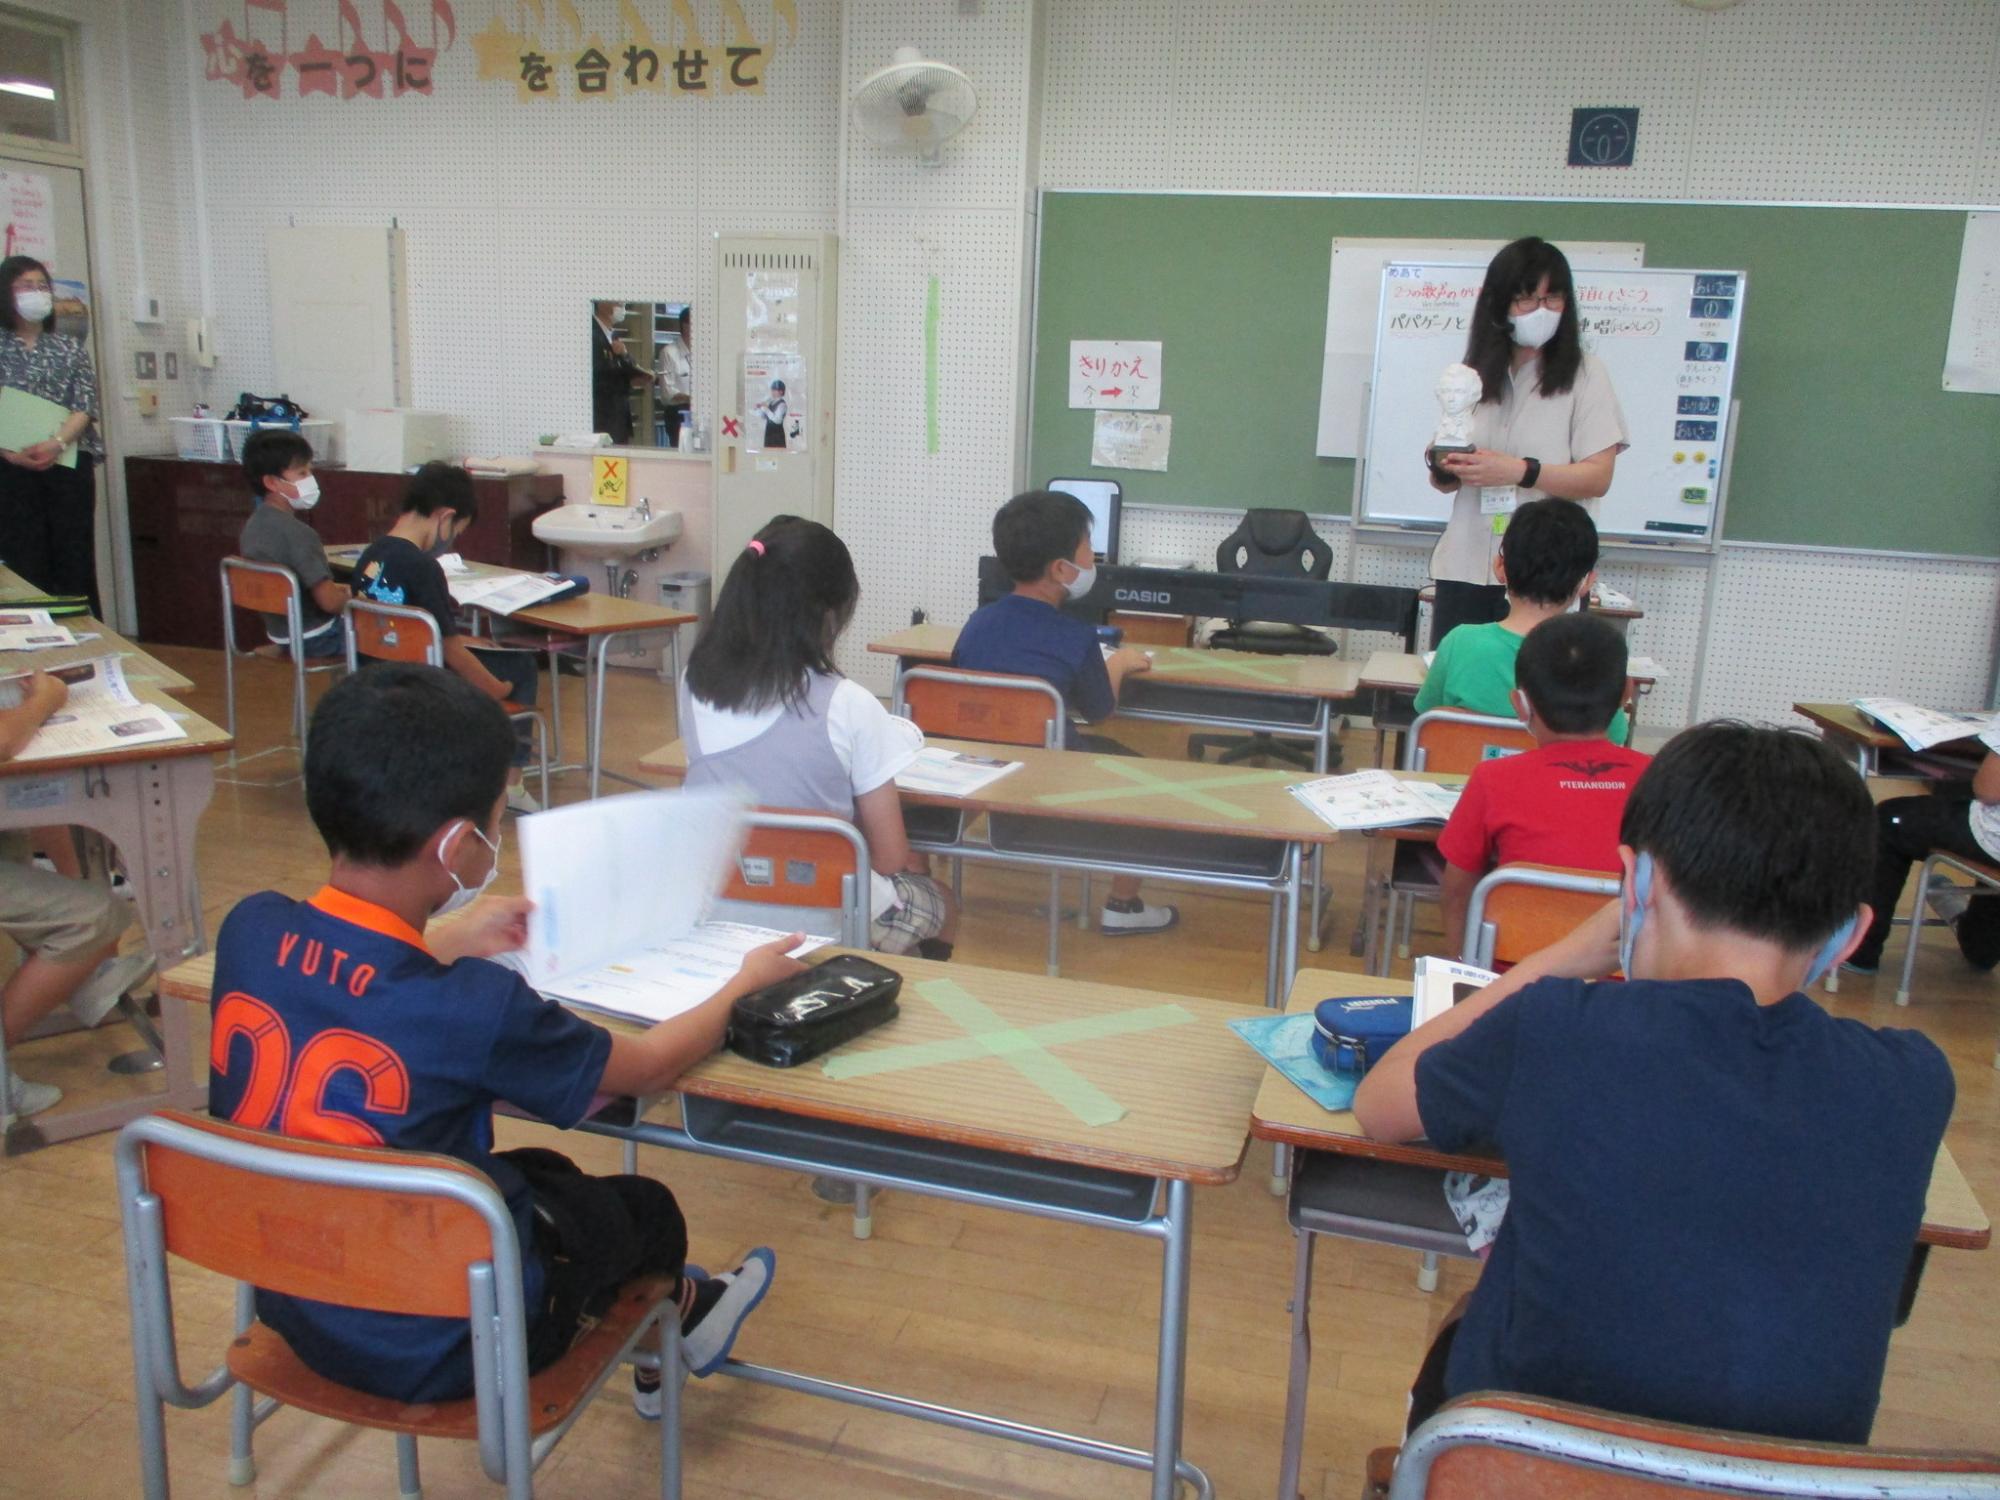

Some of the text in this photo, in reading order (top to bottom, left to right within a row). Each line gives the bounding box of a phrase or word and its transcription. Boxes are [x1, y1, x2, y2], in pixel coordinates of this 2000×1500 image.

[520, 45, 762, 93] を合わせて
[1388, 268, 1422, 279] めあて
[1114, 588, 1171, 604] CASIO
[277, 931, 376, 997] YUTO
